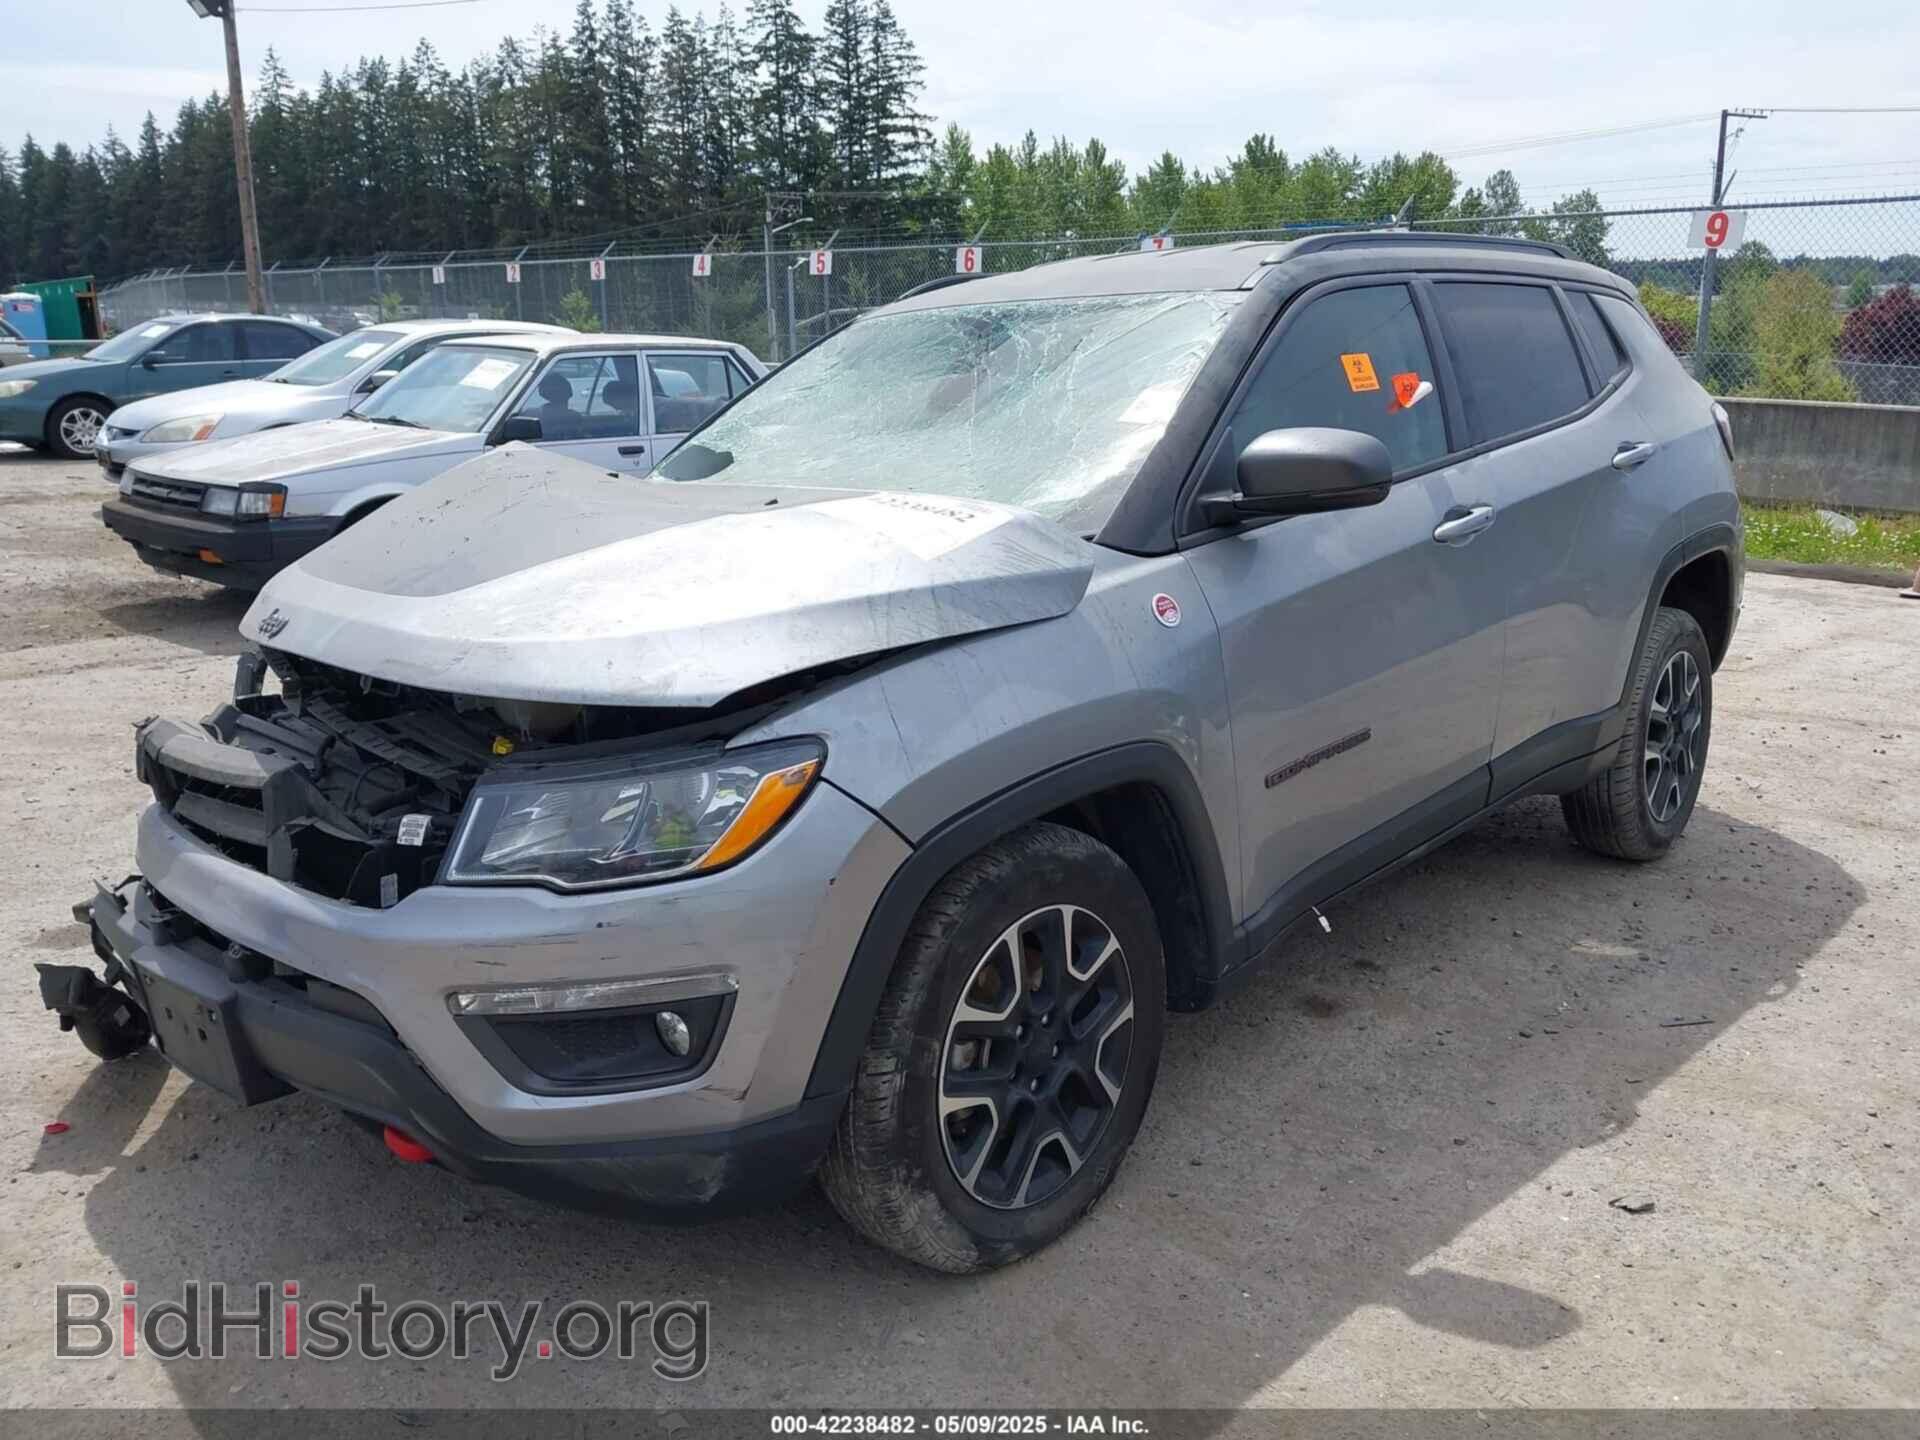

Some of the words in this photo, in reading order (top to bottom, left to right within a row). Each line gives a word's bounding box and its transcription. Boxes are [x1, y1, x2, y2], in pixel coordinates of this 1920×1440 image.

[1705, 212, 1729, 247] 9
[594, 260, 602, 278] 3
[697, 255, 706, 273] 4
[816, 252, 826, 274] 5
[964, 248, 974, 272] 6
[510, 264, 518, 281] 2
